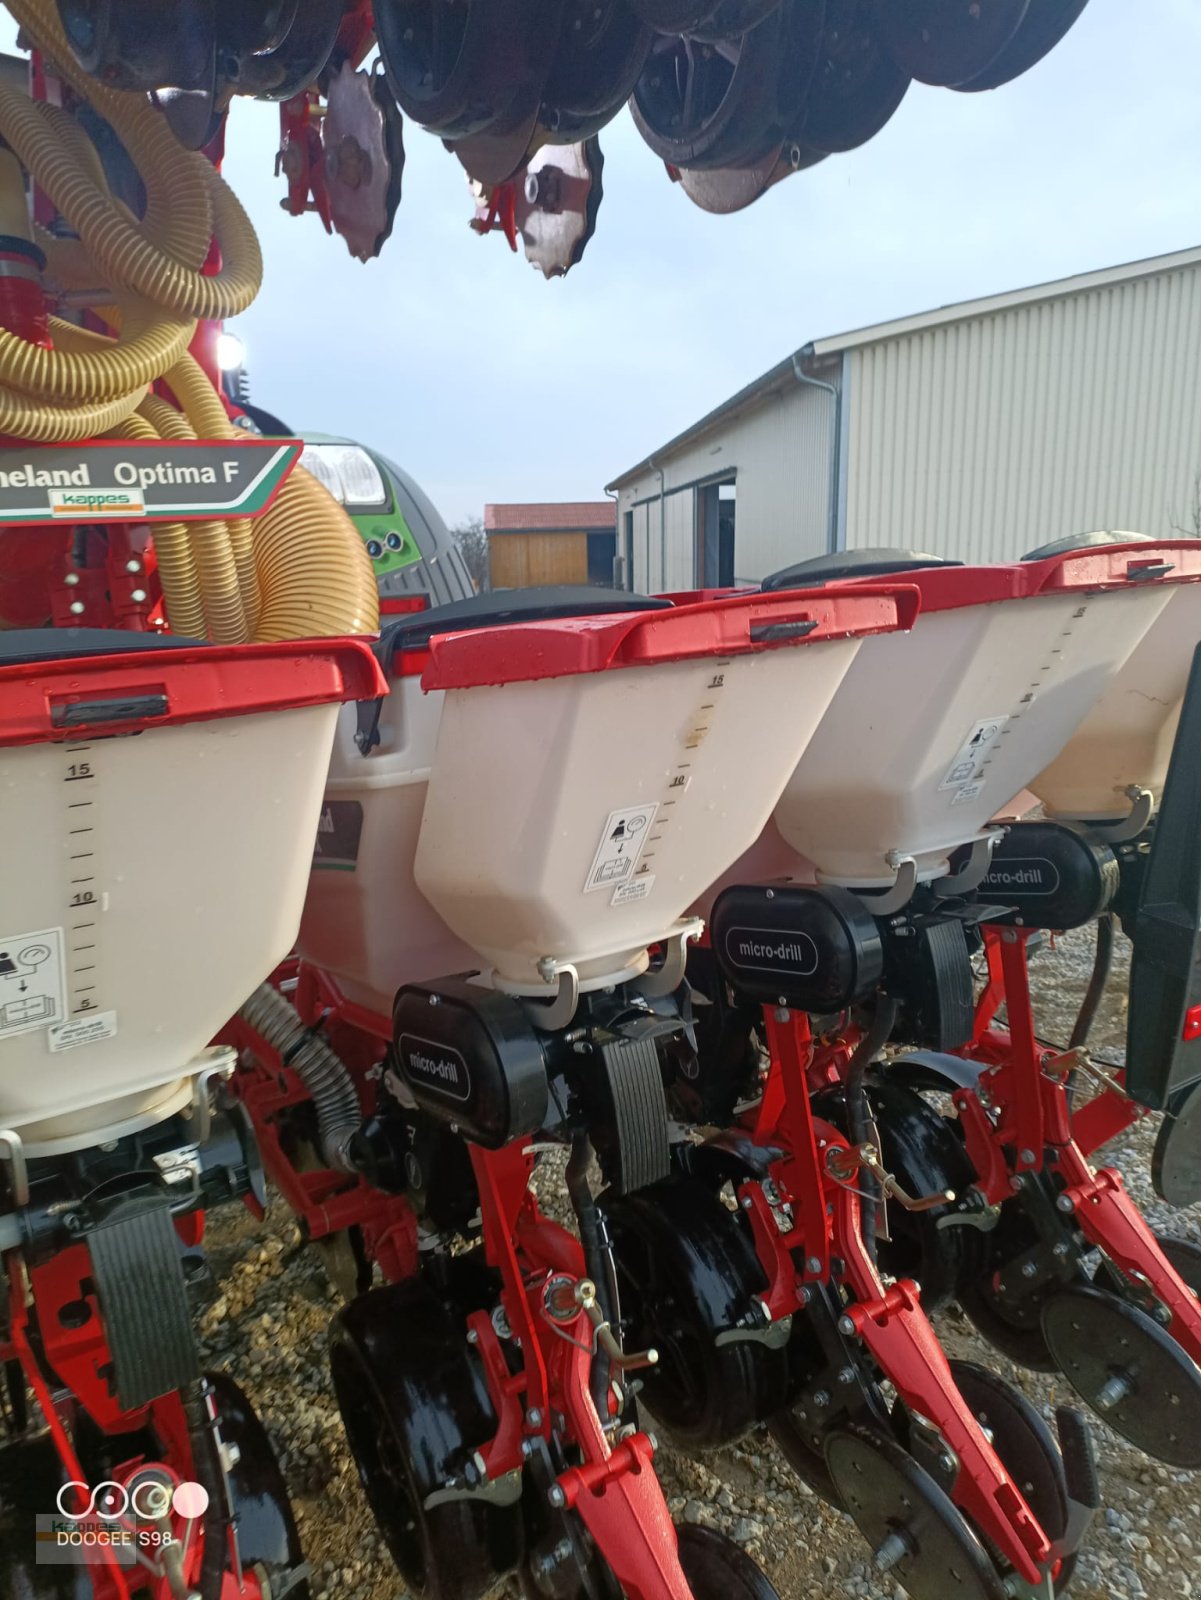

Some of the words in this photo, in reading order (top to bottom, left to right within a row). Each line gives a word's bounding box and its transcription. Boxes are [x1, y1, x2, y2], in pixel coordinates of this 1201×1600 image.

[114, 461, 217, 490] Optima
[222, 461, 239, 483] F
[62, 493, 131, 511] kappes
[712, 674, 725, 685] 15
[68, 763, 91, 777] 15
[984, 868, 1042, 884] icro-drill
[73, 891, 94, 903] 10
[739, 940, 802, 961] micro-drill
[81, 998, 91, 1009] 5
[409, 1051, 459, 1084] micro-drill
